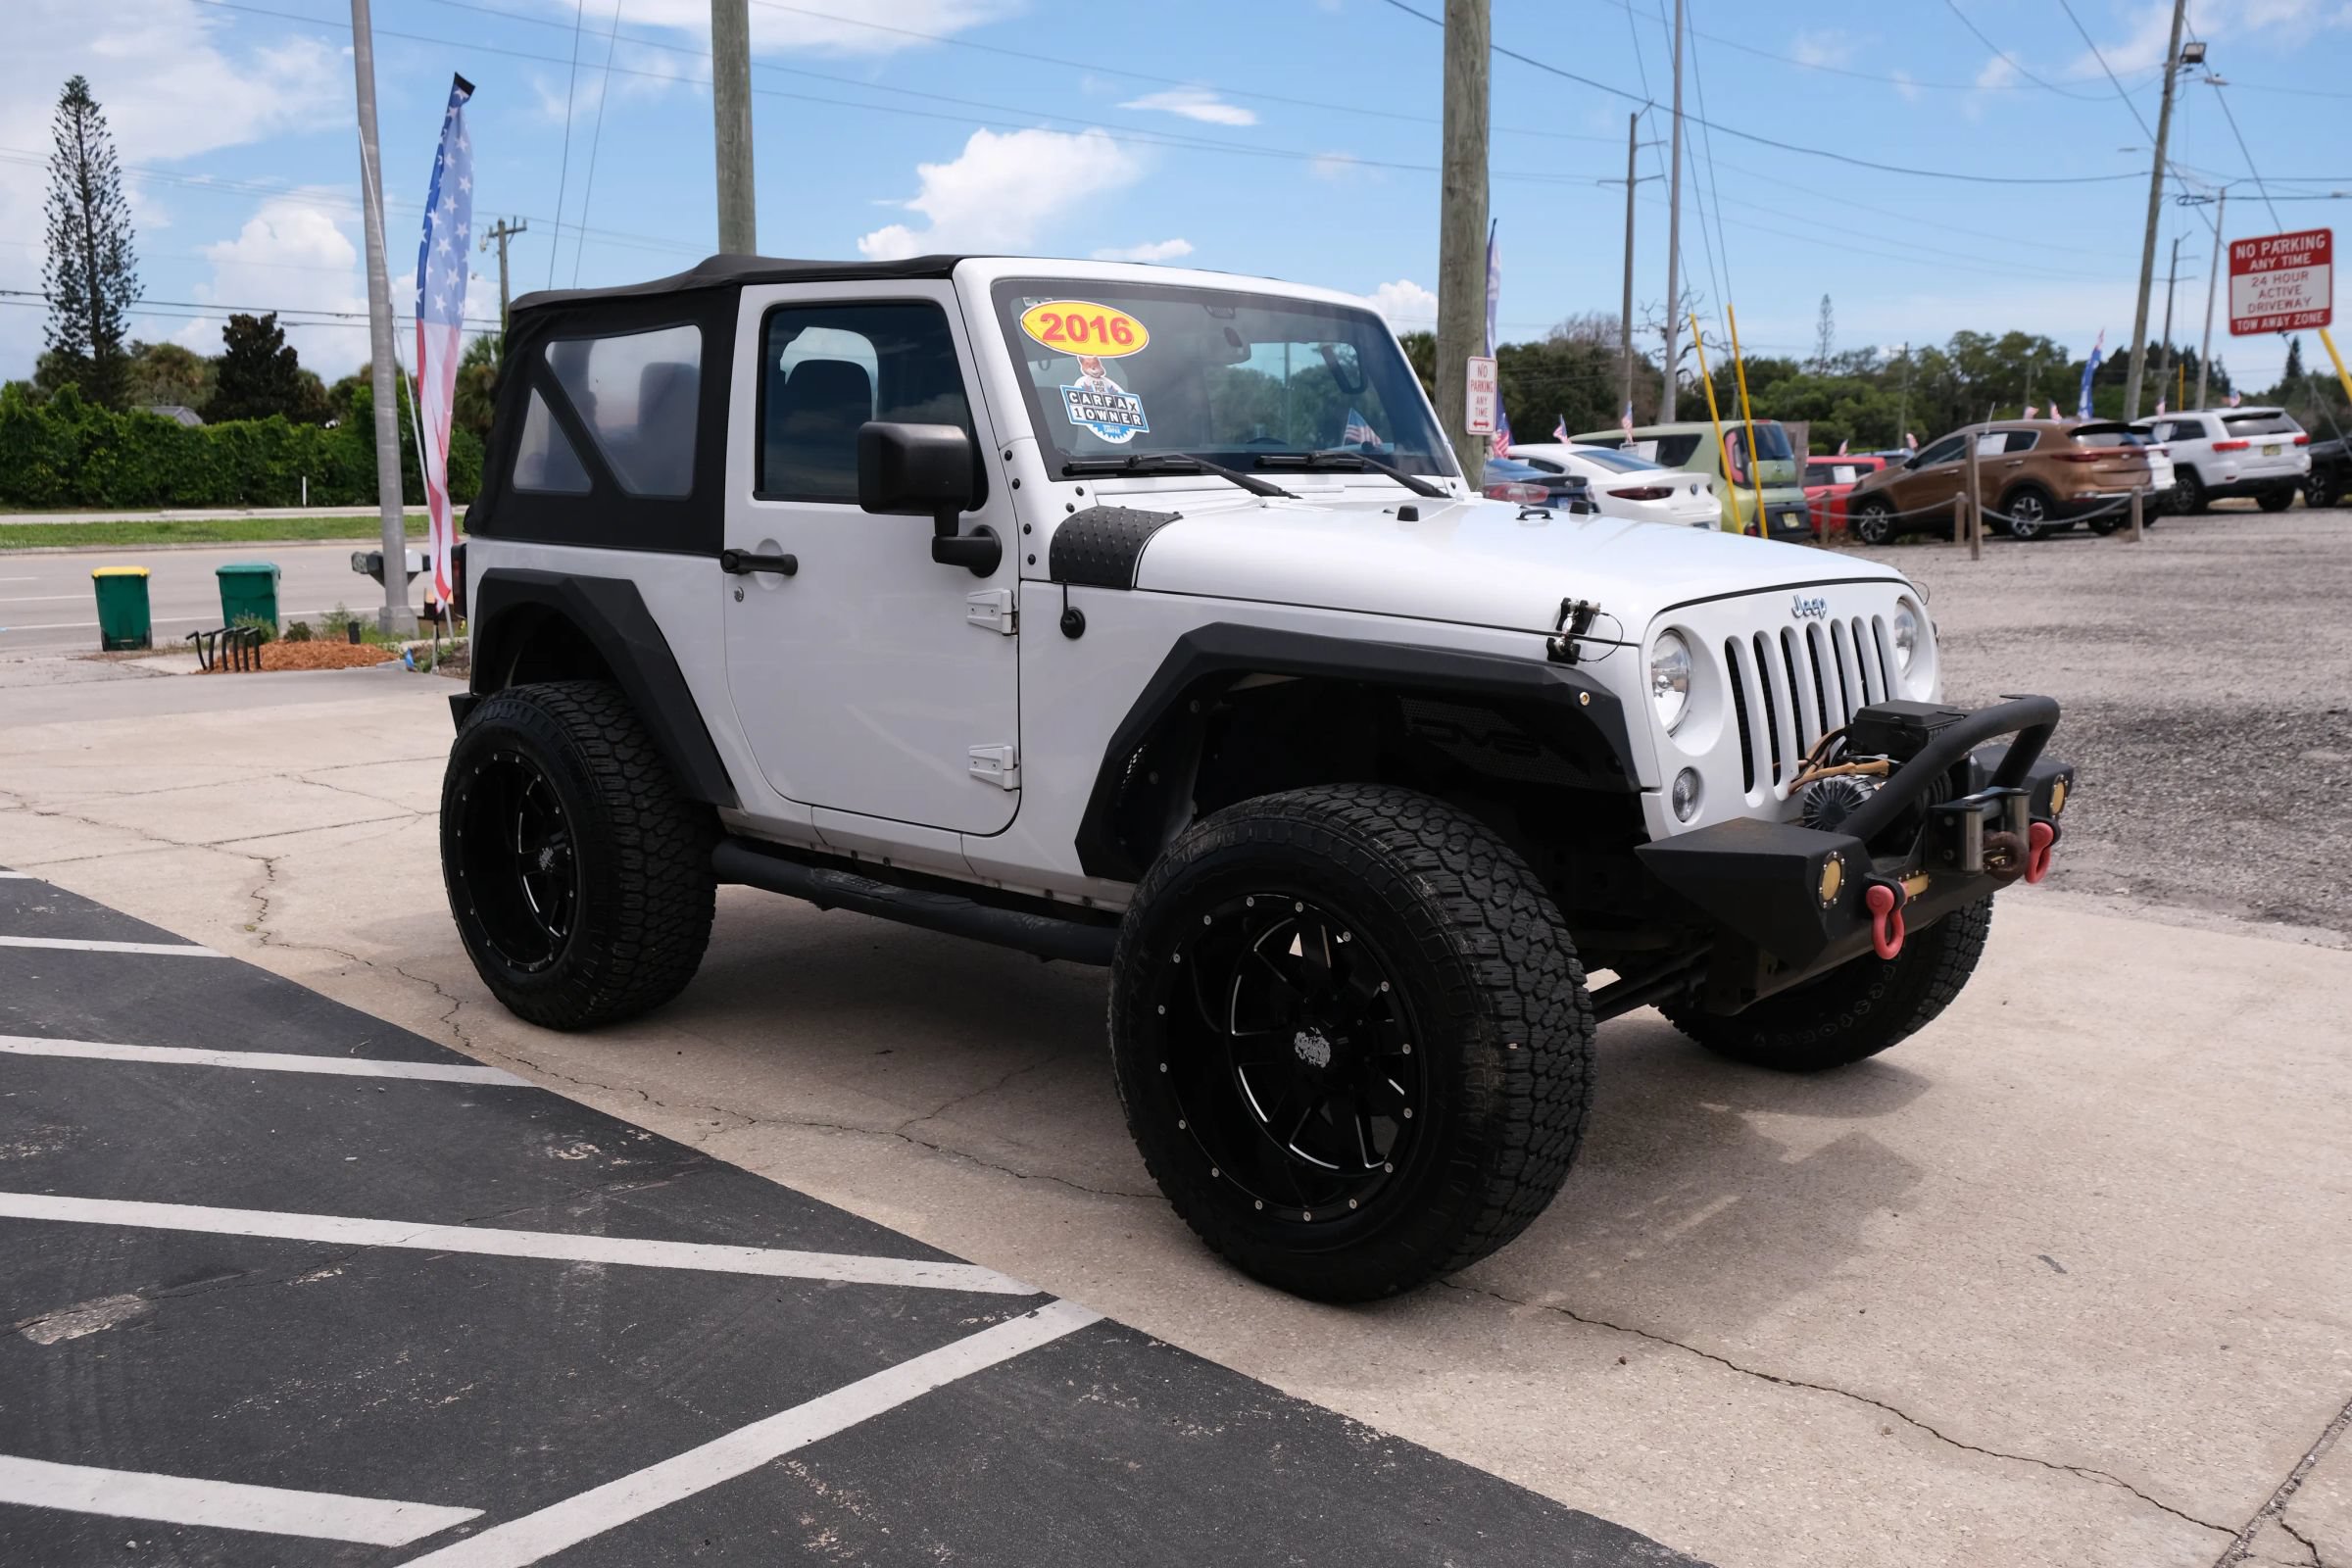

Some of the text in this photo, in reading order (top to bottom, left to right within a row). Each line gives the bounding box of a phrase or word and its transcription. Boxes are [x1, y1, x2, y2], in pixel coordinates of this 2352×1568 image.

[2235, 233, 2326, 260] NO PARKING
[2249, 253, 2312, 271] ANY TIME
[2251, 270, 2309, 288] 24 HOUR
[2258, 284, 2303, 299] ACTIVE
[2247, 296, 2313, 314] DRIVEWAY
[1040, 313, 1134, 346] 2016
[2236, 312, 2325, 331] TOW AWAY ZONE
[1477, 363, 1488, 378] NO
[1470, 379, 1494, 393] PARKING
[1068, 392, 1137, 412] CARFAX
[1476, 396, 1488, 406] ANY
[1074, 408, 1143, 425] 1 OWNER
[1475, 407, 1488, 417] TIME
[1791, 594, 1827, 619] Jeep
